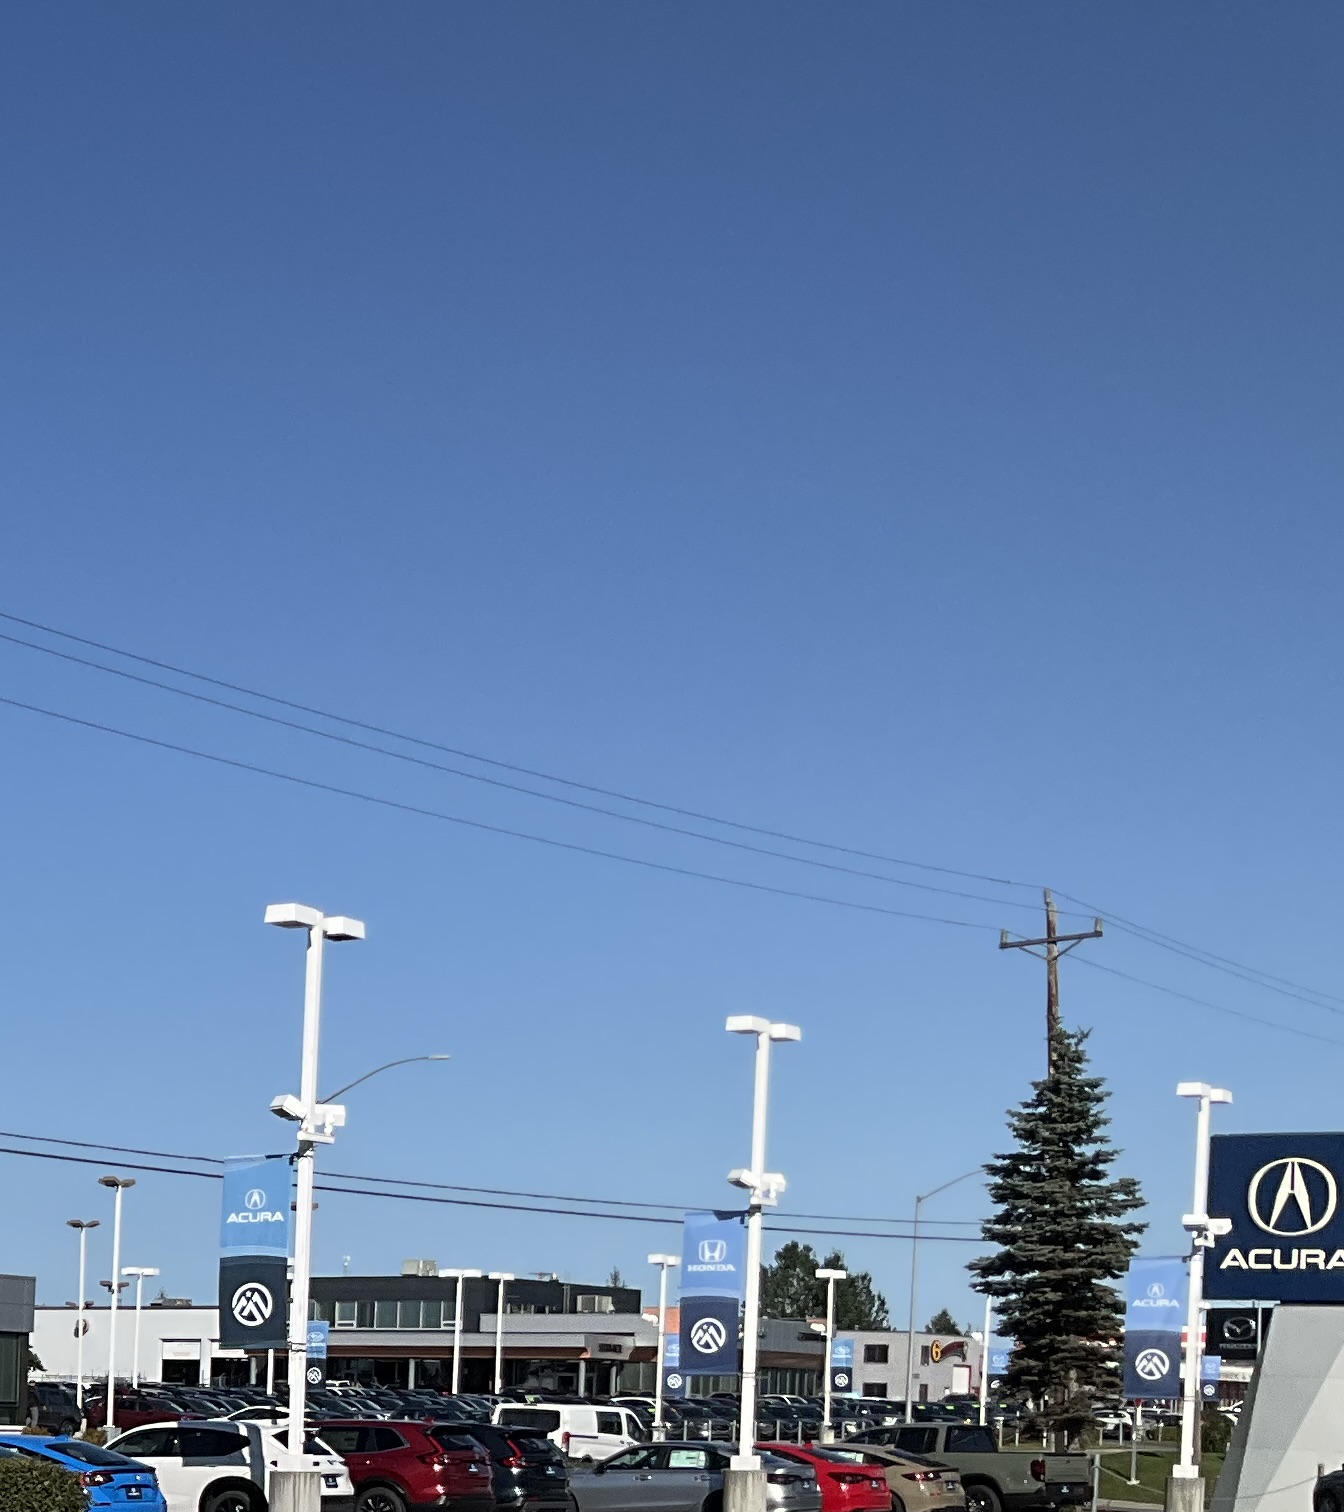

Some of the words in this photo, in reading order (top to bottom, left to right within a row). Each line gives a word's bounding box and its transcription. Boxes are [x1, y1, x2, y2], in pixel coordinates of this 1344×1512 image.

[226, 1211, 284, 1223] ACURA
[1219, 1248, 1344, 1270] ACURA
[687, 1263, 736, 1272] HONDA
[1131, 1299, 1180, 1308] ACURA
